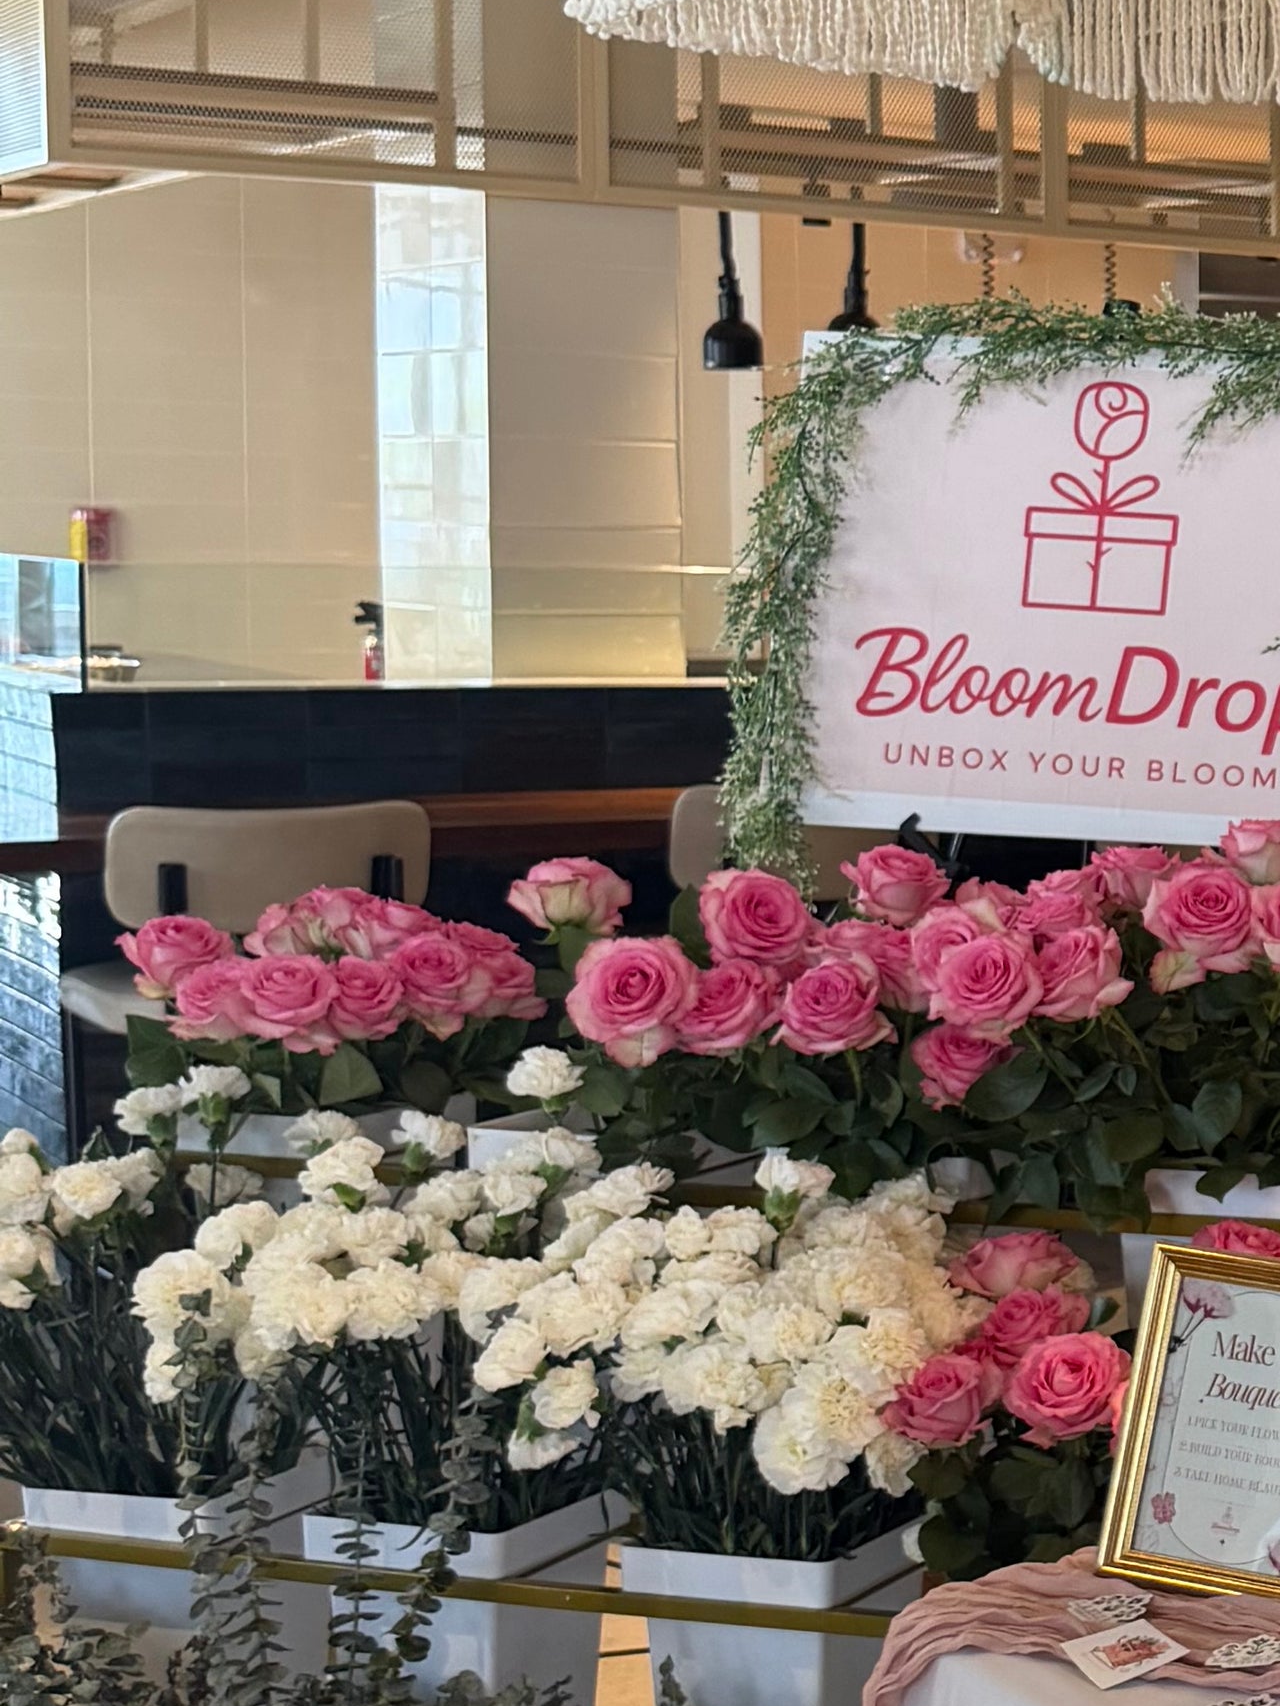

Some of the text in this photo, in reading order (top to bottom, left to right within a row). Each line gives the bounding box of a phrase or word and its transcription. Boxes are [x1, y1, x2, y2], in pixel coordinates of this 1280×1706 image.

[883, 741, 1279, 790] UNBOX YOUR BLOOM
[1211, 1331, 1276, 1367] Make
[1221, 1421, 1250, 1436] YOUR
[1224, 1448, 1253, 1463] YOUR
[1214, 1473, 1248, 1489] HOME
